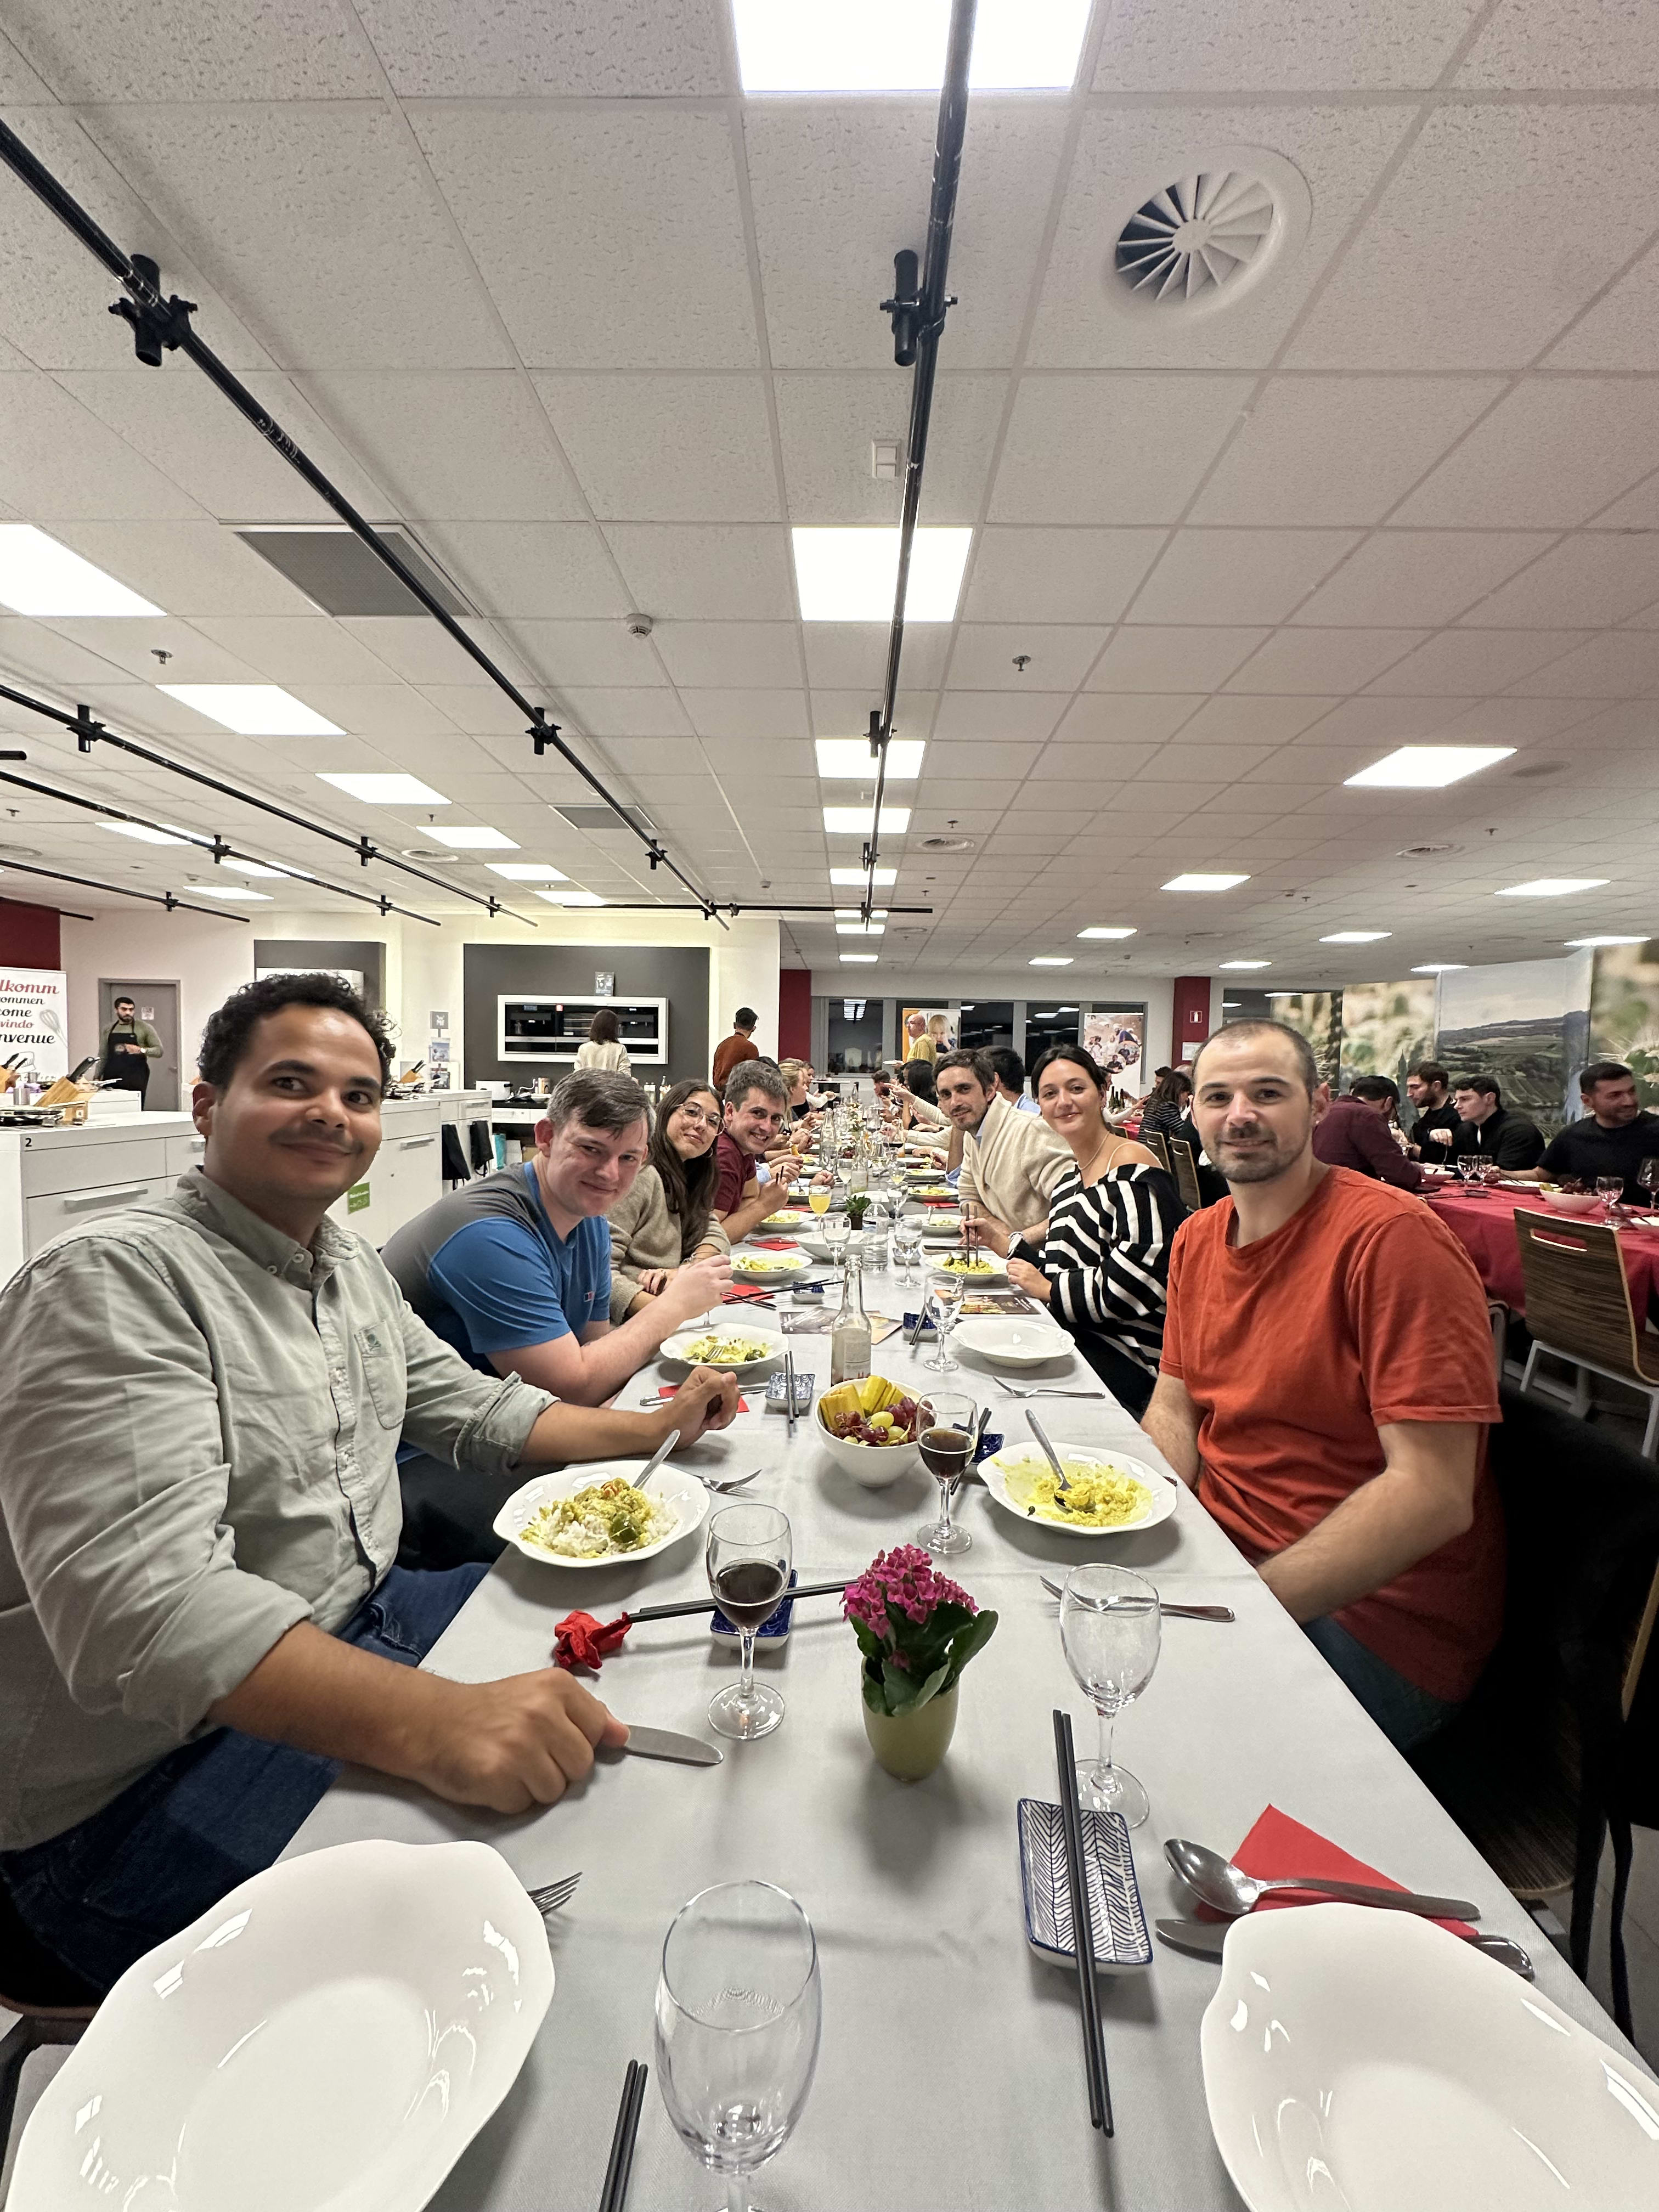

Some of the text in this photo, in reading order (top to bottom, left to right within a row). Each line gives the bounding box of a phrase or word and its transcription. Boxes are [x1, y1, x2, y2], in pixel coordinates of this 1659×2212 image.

[0, 979, 59, 994] lkomm
[0, 996, 45, 1005] ommen
[0, 1019, 34, 1029] vindo
[25, 1137, 32, 1147] 2
